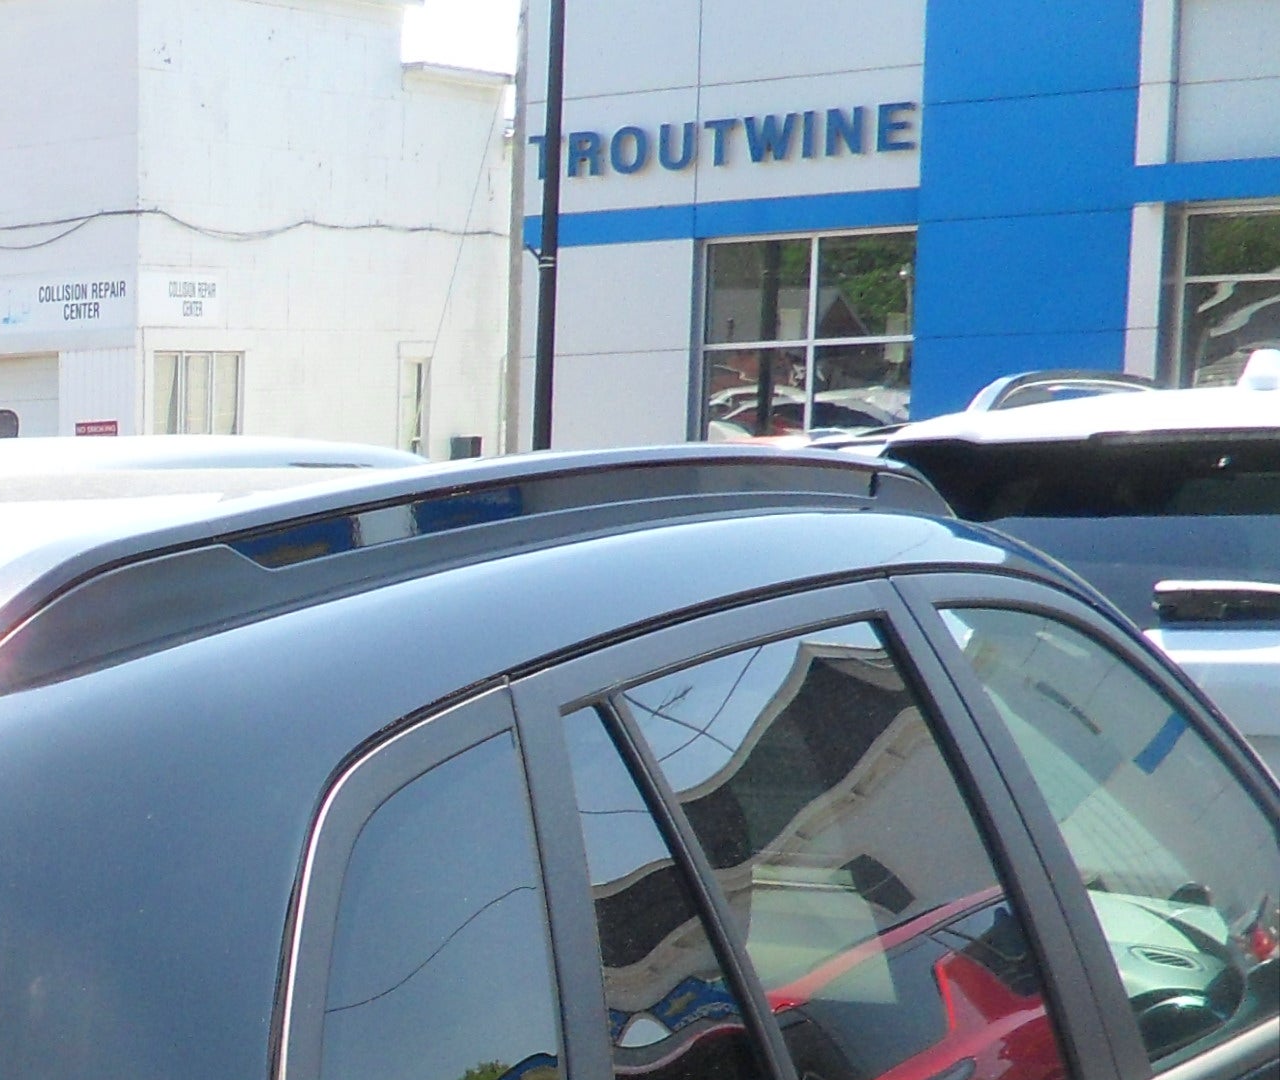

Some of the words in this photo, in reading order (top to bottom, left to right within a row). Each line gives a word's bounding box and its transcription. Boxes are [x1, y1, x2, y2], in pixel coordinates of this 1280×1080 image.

[528, 101, 917, 181] TROUTWINE
[38, 283, 88, 304] COLLISION
[91, 280, 127, 299] REPAIR
[168, 281, 196, 298] COLLISION
[197, 281, 217, 298] REPAIR
[63, 302, 101, 321] CENTER
[182, 300, 203, 317] CENTER
